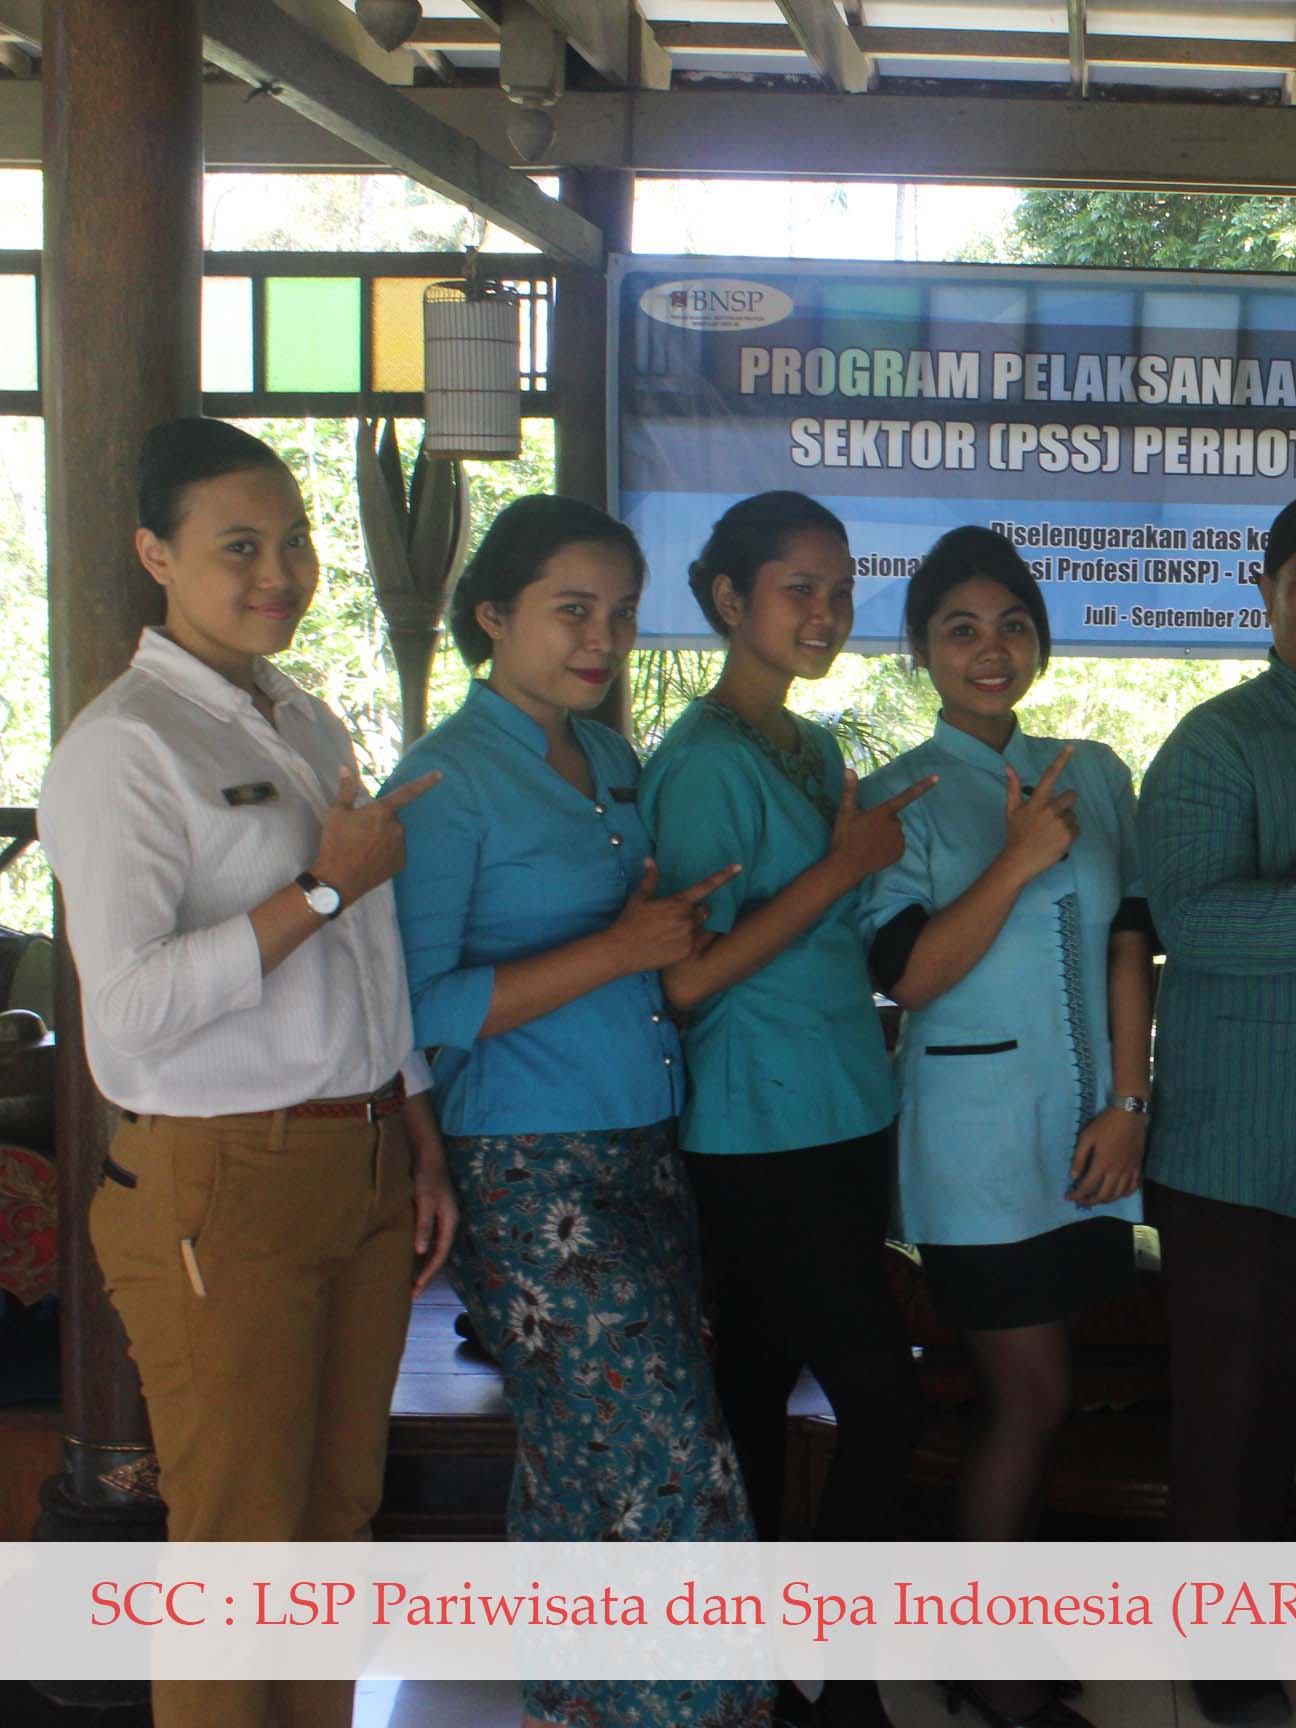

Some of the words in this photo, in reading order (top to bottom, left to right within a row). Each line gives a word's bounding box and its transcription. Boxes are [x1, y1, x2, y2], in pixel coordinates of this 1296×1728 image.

[693, 290, 765, 313] BNSP
[739, 346, 980, 400] PROGRAM
[790, 418, 977, 470] SEKTOR
[988, 423, 1121, 474] (PSS)
[1192, 528, 1242, 551] atas
[1247, 526, 1272, 551] ke
[1057, 557, 1138, 583] Profesi
[1144, 559, 1220, 585] (BNSP)
[1238, 560, 1263, 586] LS
[1084, 605, 1117, 626] Juli
[1131, 606, 1235, 629] September
[1238, 608, 1271, 629] 201
